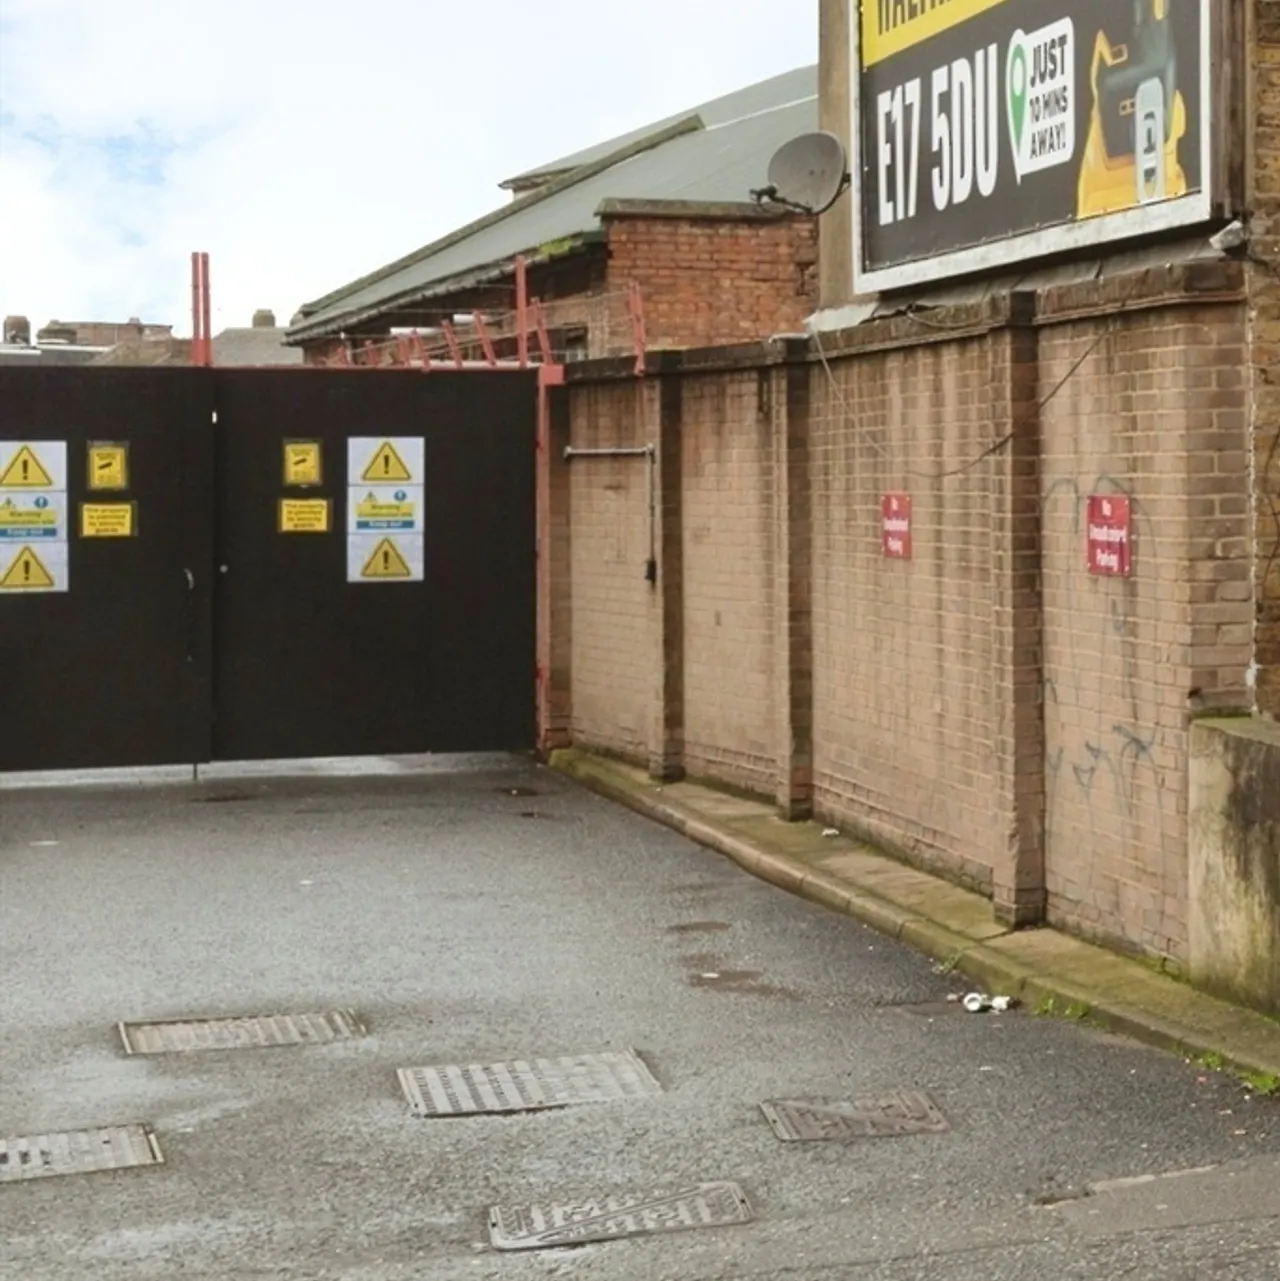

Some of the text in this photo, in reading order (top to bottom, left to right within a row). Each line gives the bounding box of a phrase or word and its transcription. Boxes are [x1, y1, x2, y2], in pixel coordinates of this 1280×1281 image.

[1029, 33, 1068, 88] JUST
[1029, 85, 1069, 125] 10 MINS
[876, 41, 998, 227] E17 5DU
[1029, 122, 1066, 160] AWAY!
